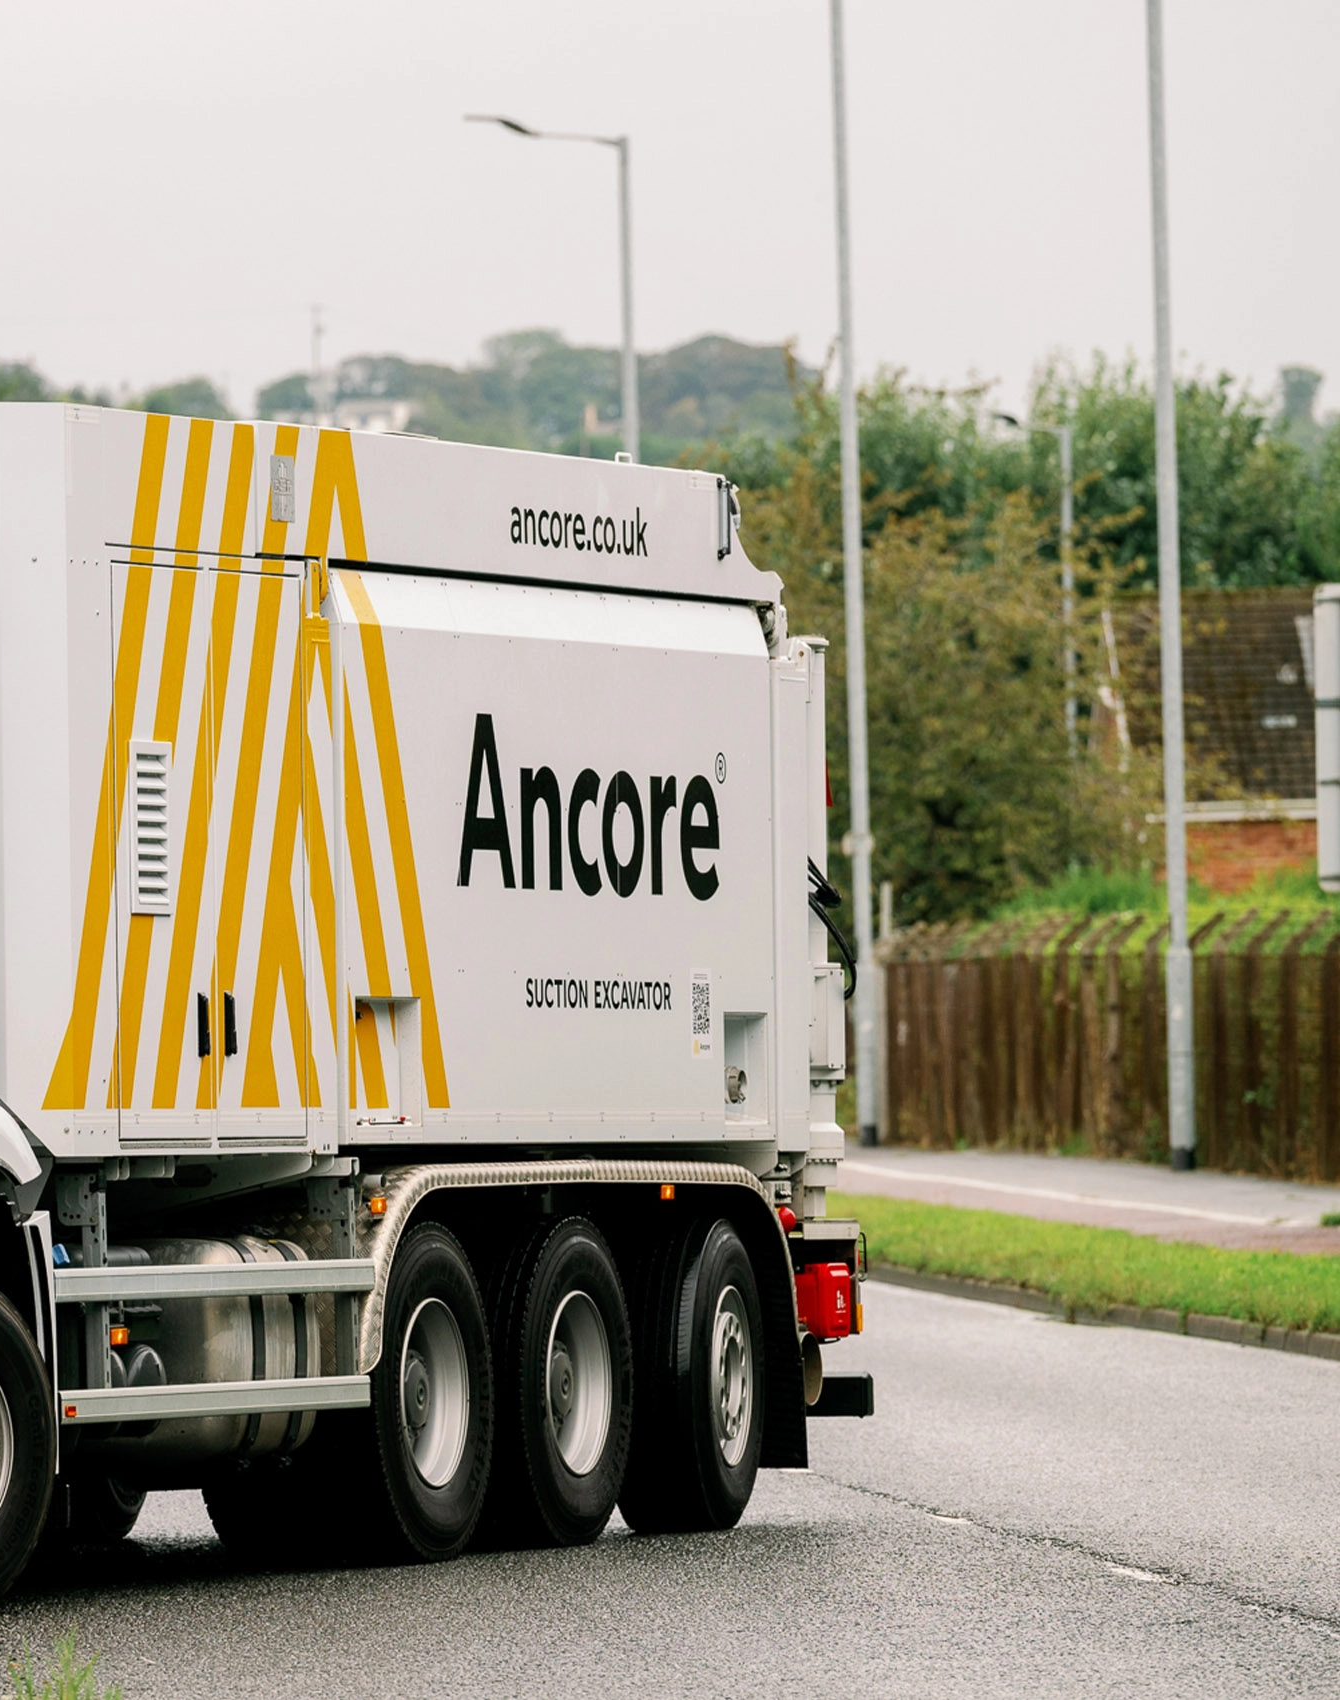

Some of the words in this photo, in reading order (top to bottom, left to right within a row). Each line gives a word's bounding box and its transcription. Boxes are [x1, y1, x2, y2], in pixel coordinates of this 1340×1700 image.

[510, 506, 648, 557] ancore.co.uk
[525, 977, 589, 1009] SUCTION
[594, 979, 672, 1011] EXCAVATOR
